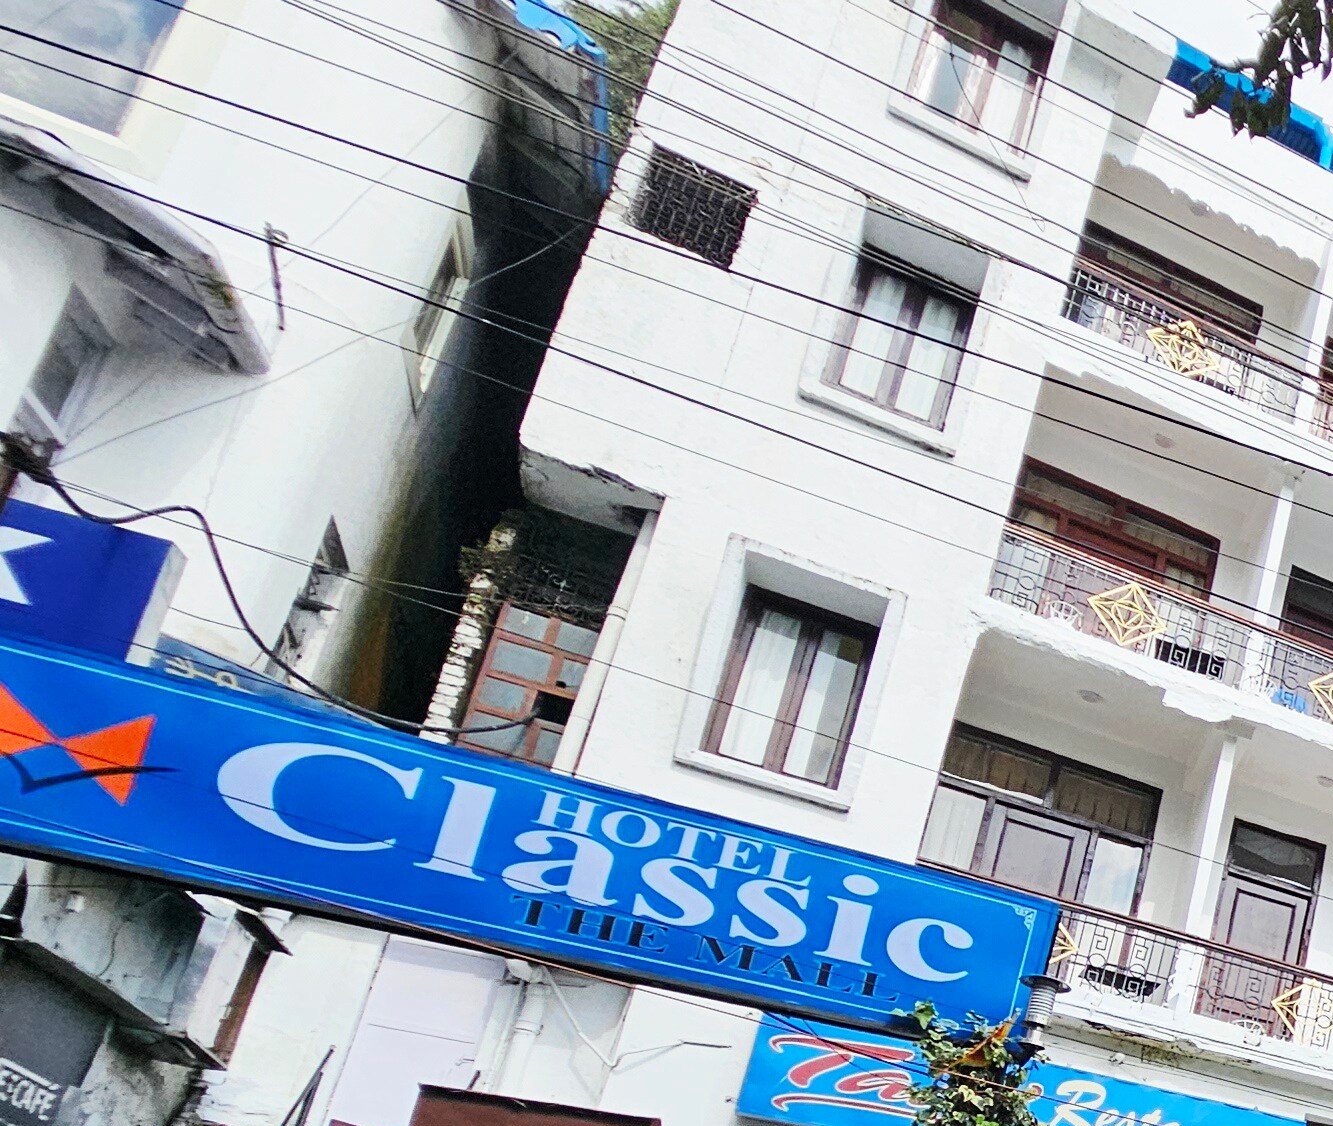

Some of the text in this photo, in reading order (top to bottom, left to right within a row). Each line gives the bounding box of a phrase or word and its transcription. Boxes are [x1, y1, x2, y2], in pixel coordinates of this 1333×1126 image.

[215, 741, 974, 984] Classic
[536, 788, 811, 887] HOTEL
[512, 893, 899, 1003] THE MALL
